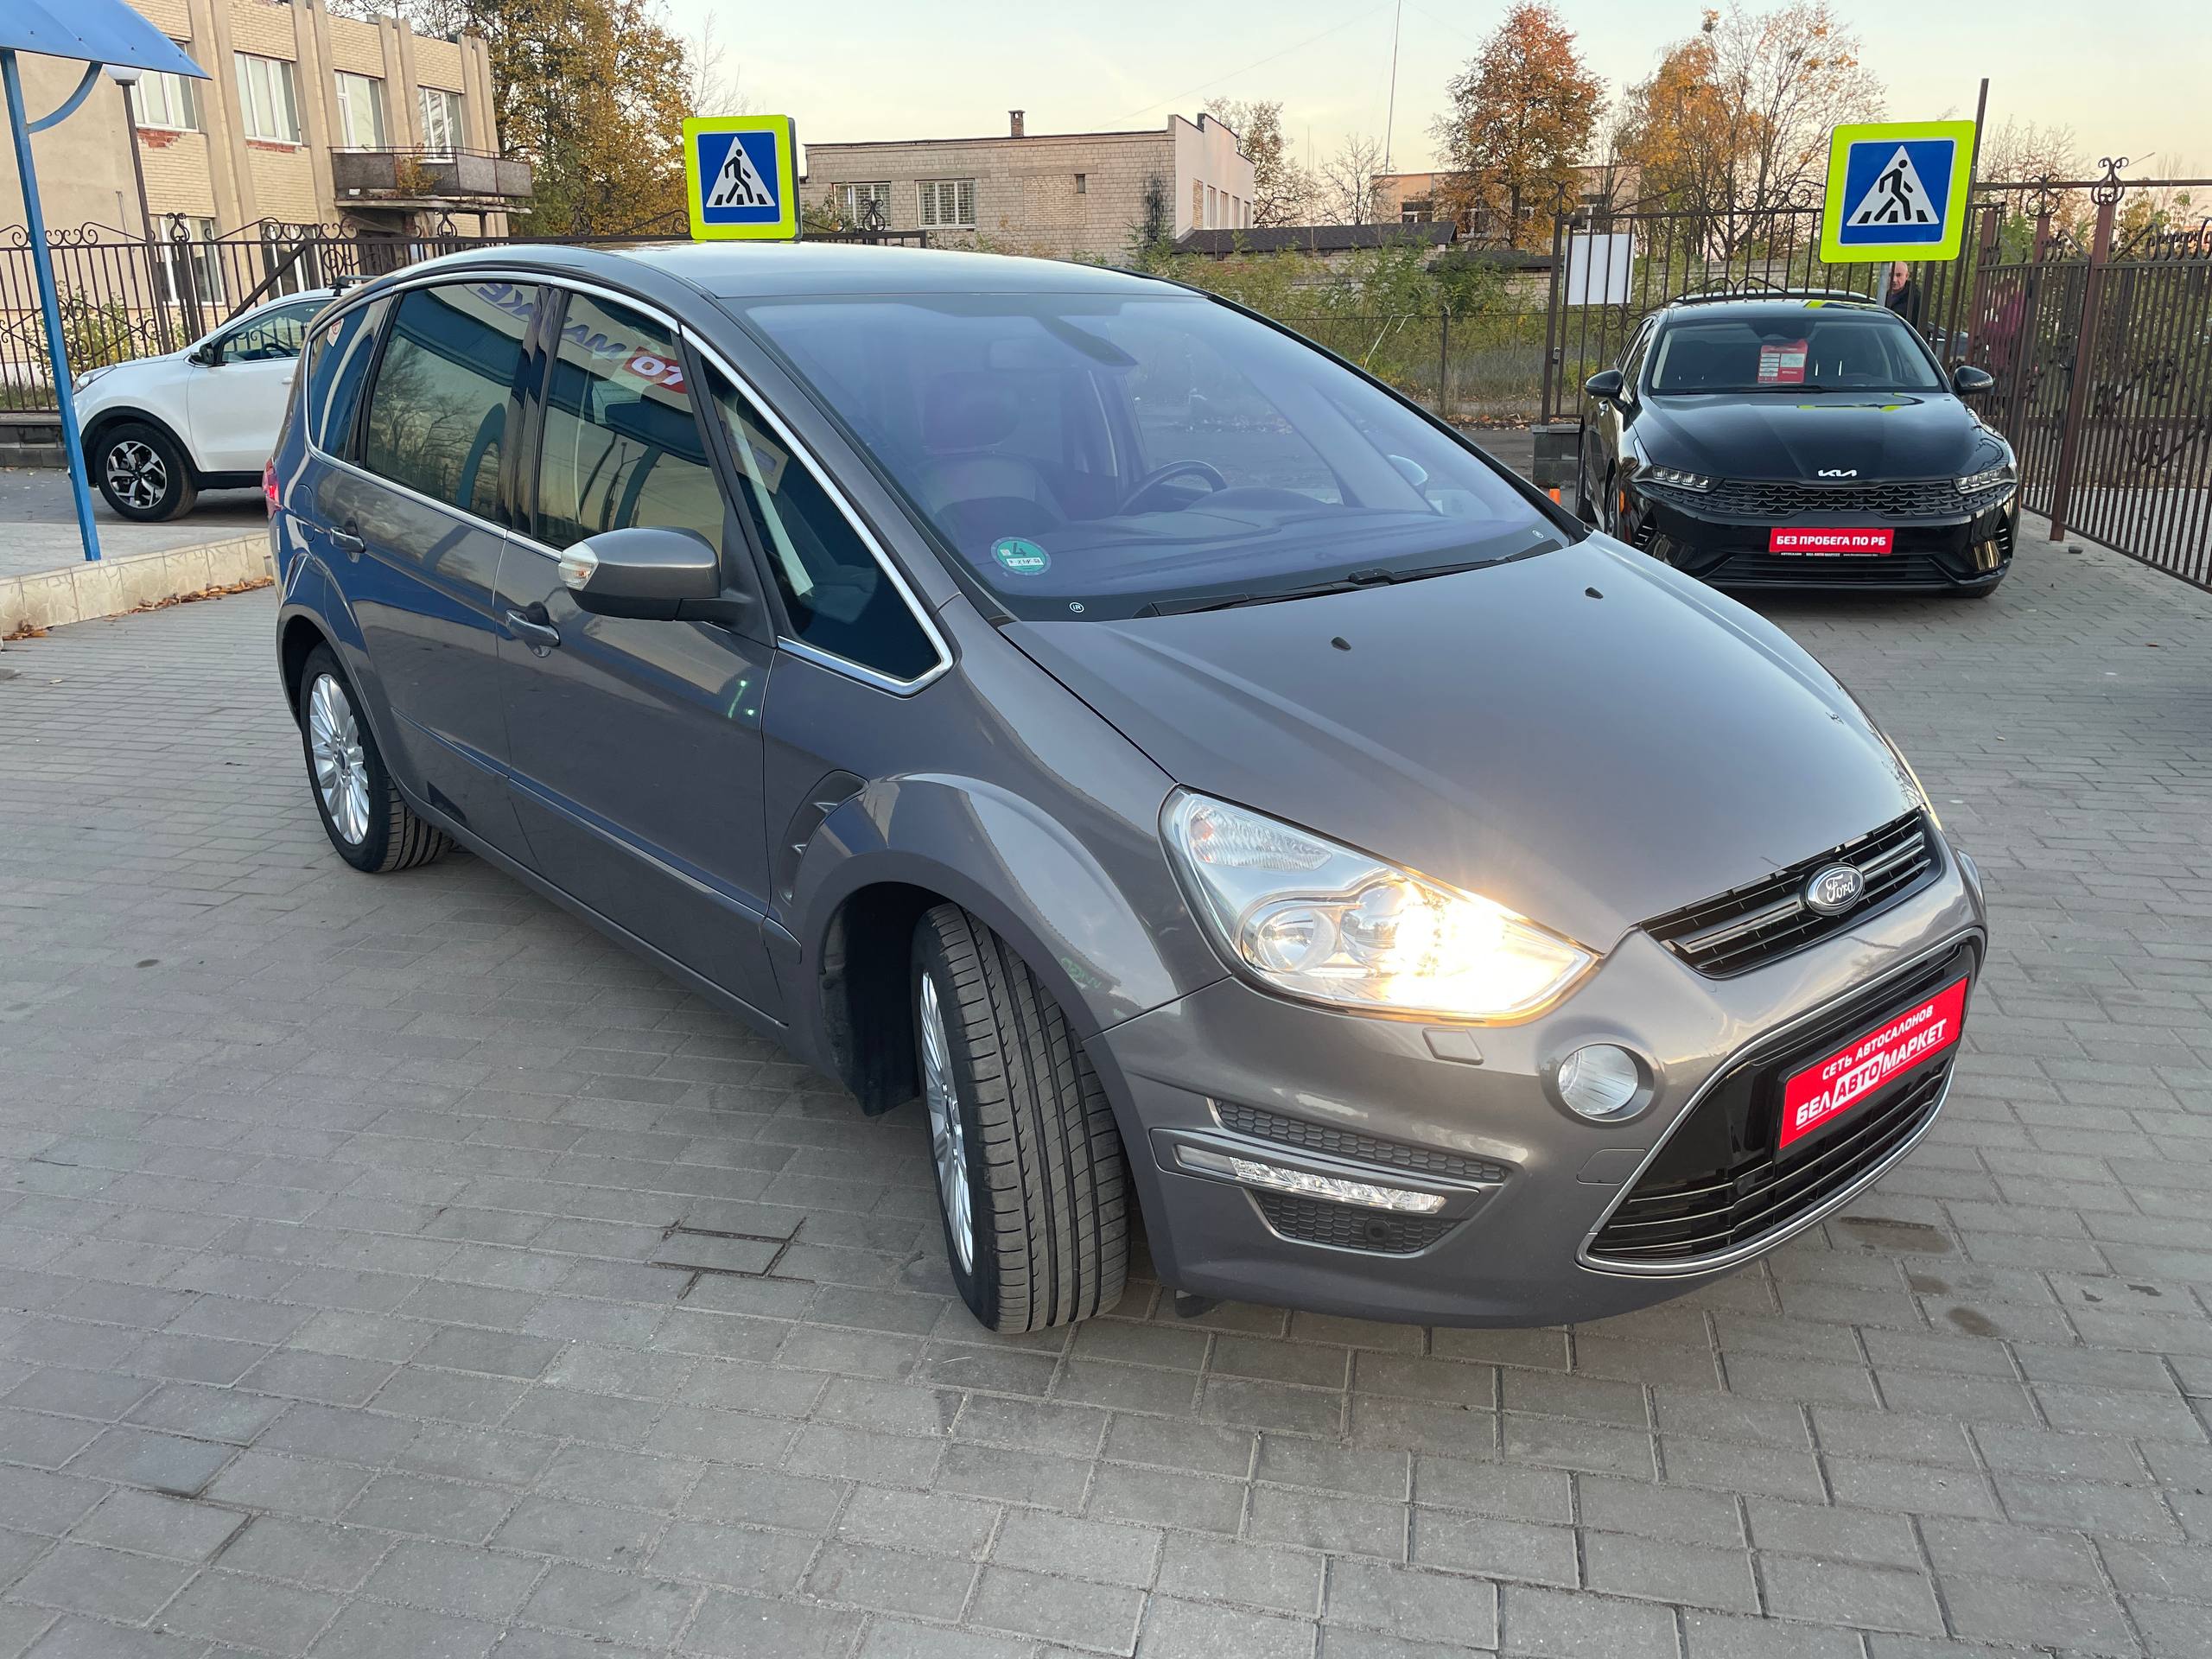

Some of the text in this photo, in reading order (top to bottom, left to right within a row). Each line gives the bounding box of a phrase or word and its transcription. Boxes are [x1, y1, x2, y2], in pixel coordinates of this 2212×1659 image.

[1777, 536, 1886, 545] БЕЗ ПРОБЕГА ПО РБ
[1826, 874, 1855, 903] Ford
[1822, 1004, 1934, 1080] СЕТЬ АВТОСАЛОНОВ
